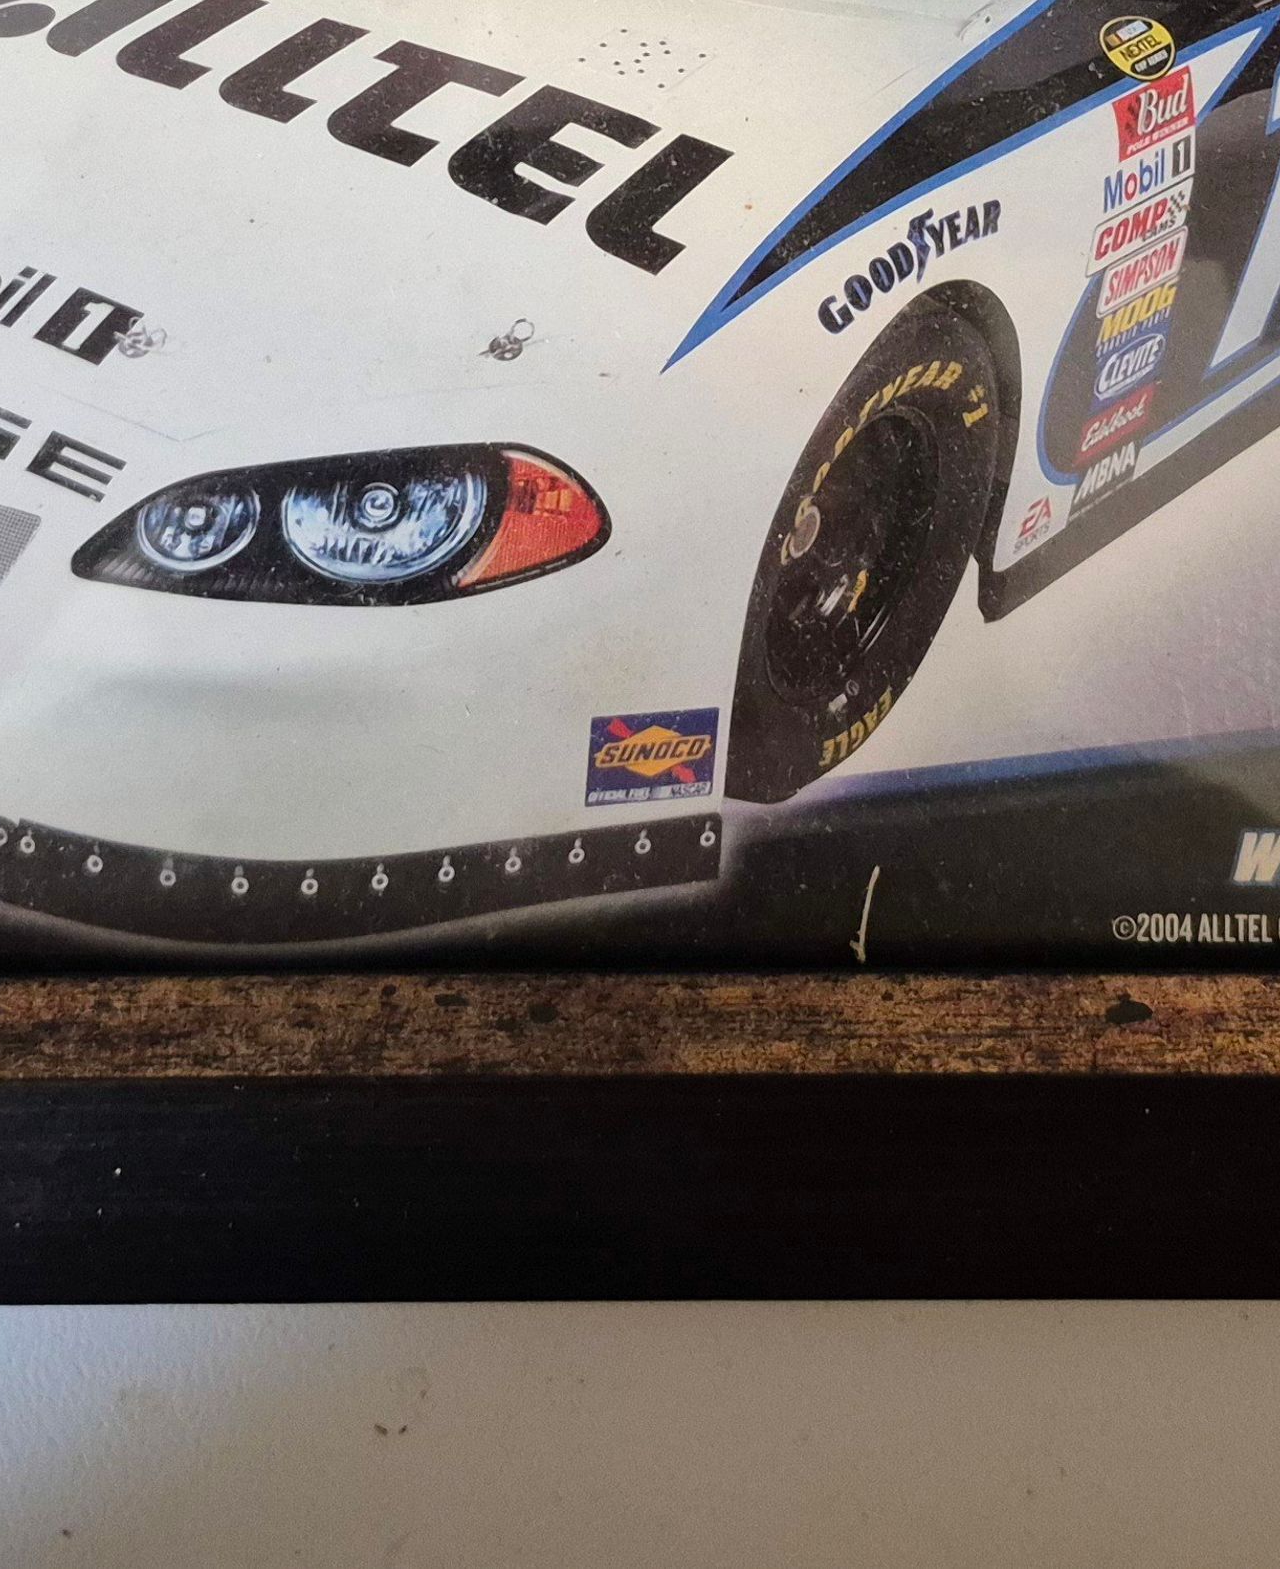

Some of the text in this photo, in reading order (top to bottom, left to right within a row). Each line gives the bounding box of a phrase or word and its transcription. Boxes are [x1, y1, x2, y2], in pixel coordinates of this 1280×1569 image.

[1119, 33, 1162, 62] NEXTEL
[1137, 72, 1190, 137] Bud
[1103, 148, 1166, 214] Mobil
[1094, 196, 1169, 262] COMP
[817, 198, 1002, 335] GOODYEAR
[1103, 236, 1181, 307] SIMPSON
[1099, 282, 1178, 343] MOOG
[1073, 441, 1136, 505] MBNA
[599, 737, 707, 765] SUNOCO
[1112, 912, 1192, 944] ©2004
[1197, 913, 1273, 944] ALLTEL
